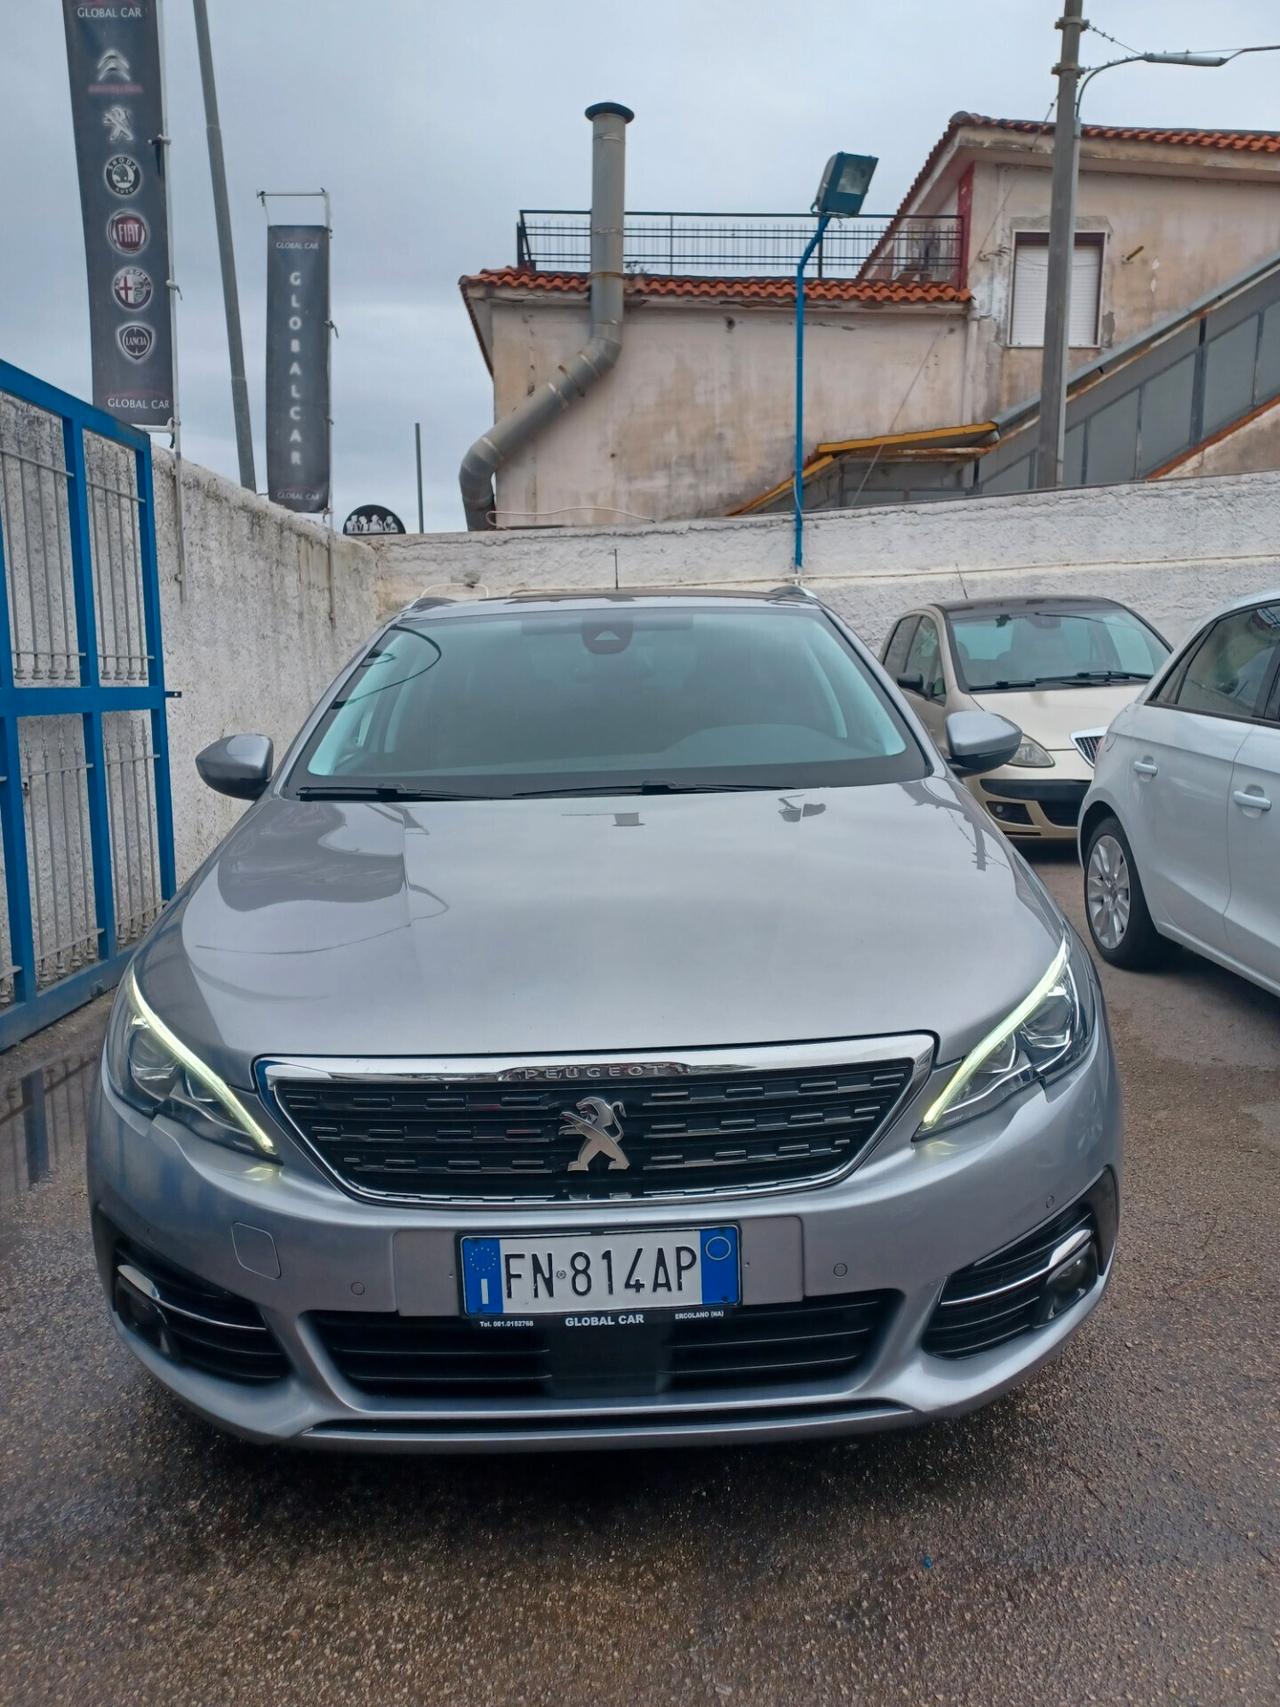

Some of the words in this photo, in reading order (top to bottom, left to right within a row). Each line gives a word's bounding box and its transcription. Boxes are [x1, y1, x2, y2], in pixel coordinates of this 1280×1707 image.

[77, 7, 117, 18] GLOBAL
[120, 7, 142, 18] CAR
[118, 223, 140, 242] FIAT
[125, 336, 147, 346] LANCIA
[107, 398, 148, 409] GLOBAL
[151, 400, 170, 409] CAR
[524, 1065, 665, 1080] PEUGEOT
[564, 1316, 615, 1327] GLOBAL
[618, 1313, 645, 1325] CAR
[674, 1311, 709, 1320] ERCOLANO
